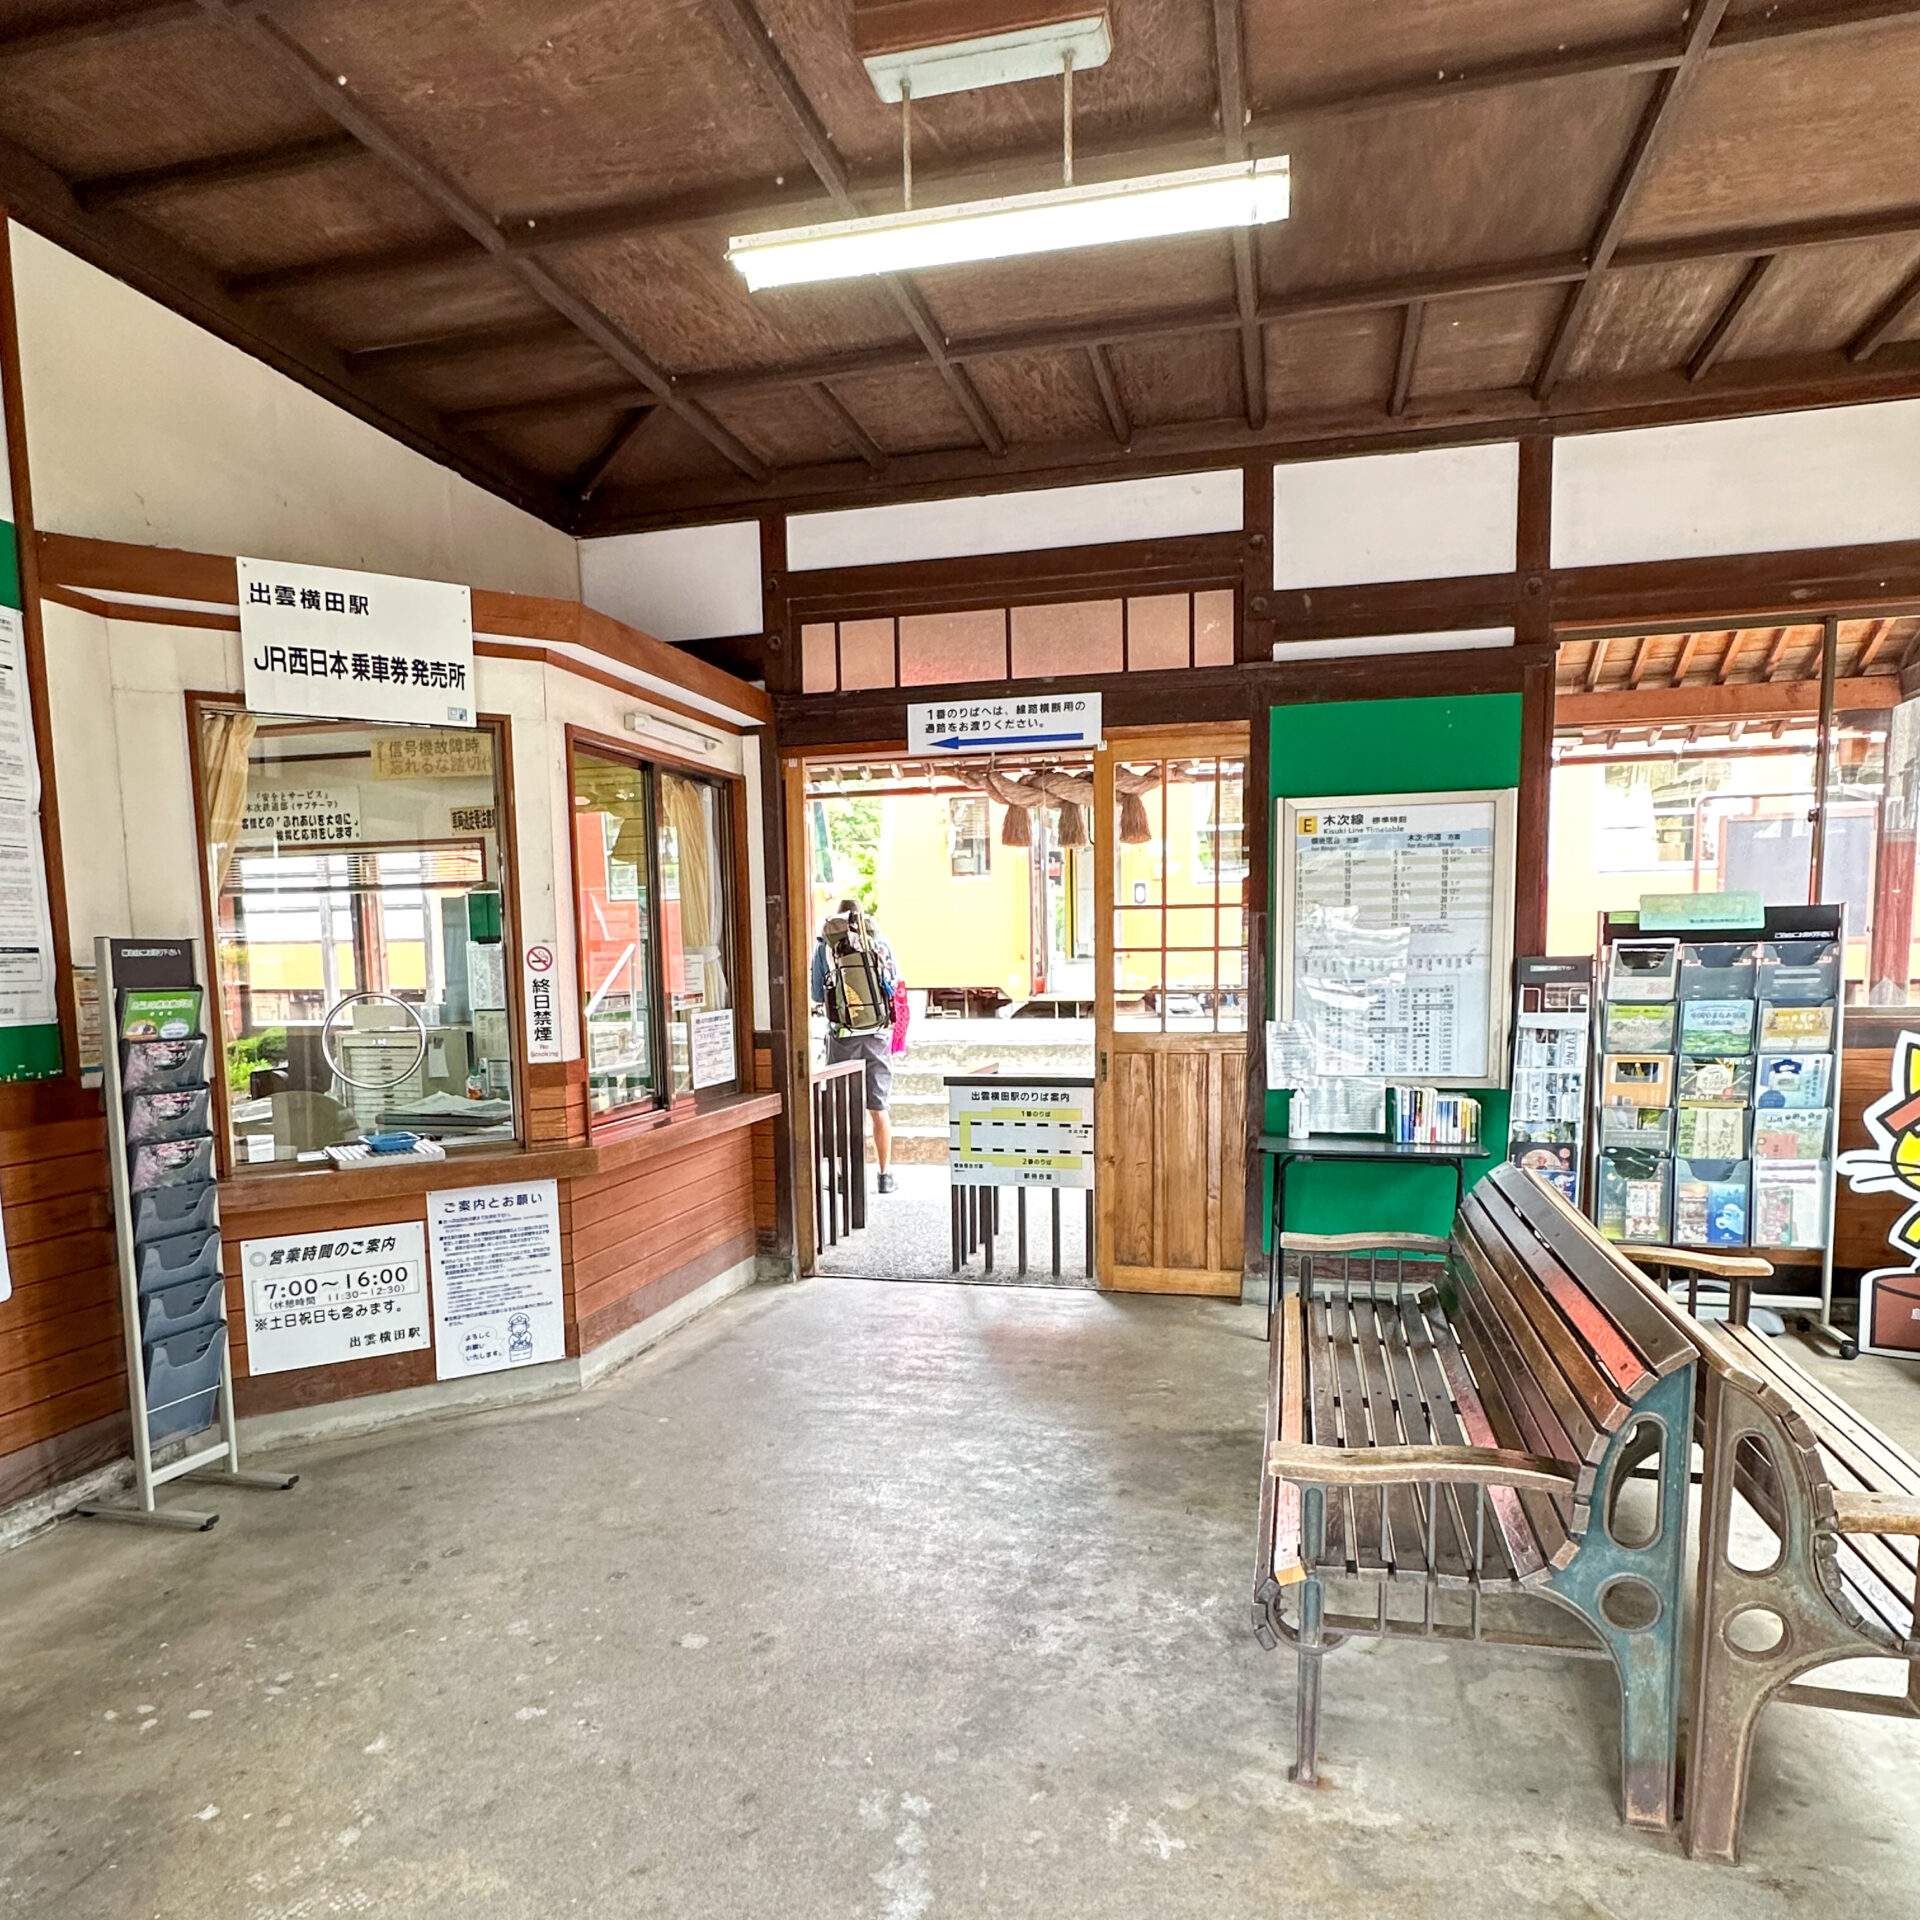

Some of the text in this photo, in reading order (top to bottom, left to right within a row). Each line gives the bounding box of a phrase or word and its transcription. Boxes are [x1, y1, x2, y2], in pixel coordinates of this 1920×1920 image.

[250, 582, 370, 616] 出雲横田駅
[254, 645, 466, 691] JR西日本乗車券発売所
[389, 736, 480, 758] 信号機故障時
[1304, 818, 1312, 833] E
[1323, 813, 1364, 827] 木次線
[1323, 827, 1346, 835] Kisuki
[532, 977, 554, 1043] 終日禁煙
[971, 1091, 1070, 1103] 出雲横田駅のりば案内
[444, 1193, 543, 1215] ご案内とお願い
[269, 1236, 397, 1266] 営業時間のご案内
[350, 1326, 422, 1349] 出雲横田駅
[465, 1331, 492, 1342] よろしく
